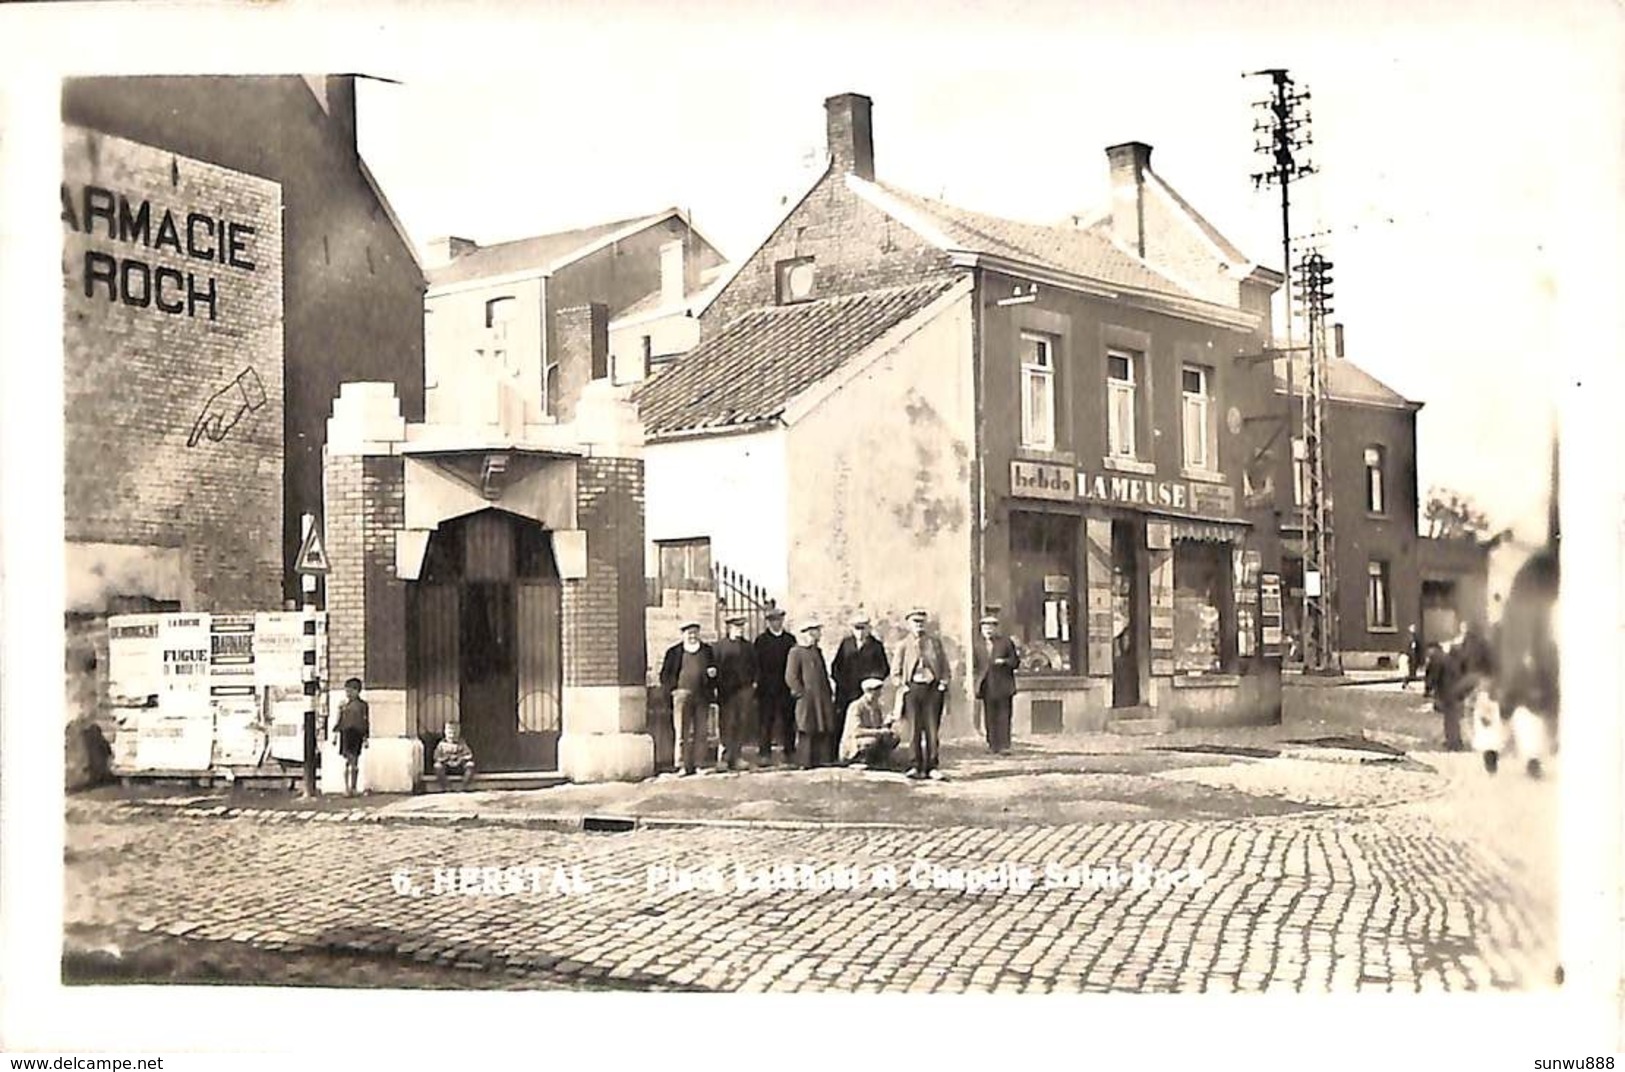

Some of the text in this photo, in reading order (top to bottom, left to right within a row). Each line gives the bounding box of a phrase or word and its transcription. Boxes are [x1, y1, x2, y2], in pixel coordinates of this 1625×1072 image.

[84, 250, 216, 320] ROCH
[1014, 465, 1071, 492] hebdo
[1077, 472, 1108, 499] LA
[1110, 476, 1187, 509] MEUSE
[163, 649, 208, 663] FUGUE
